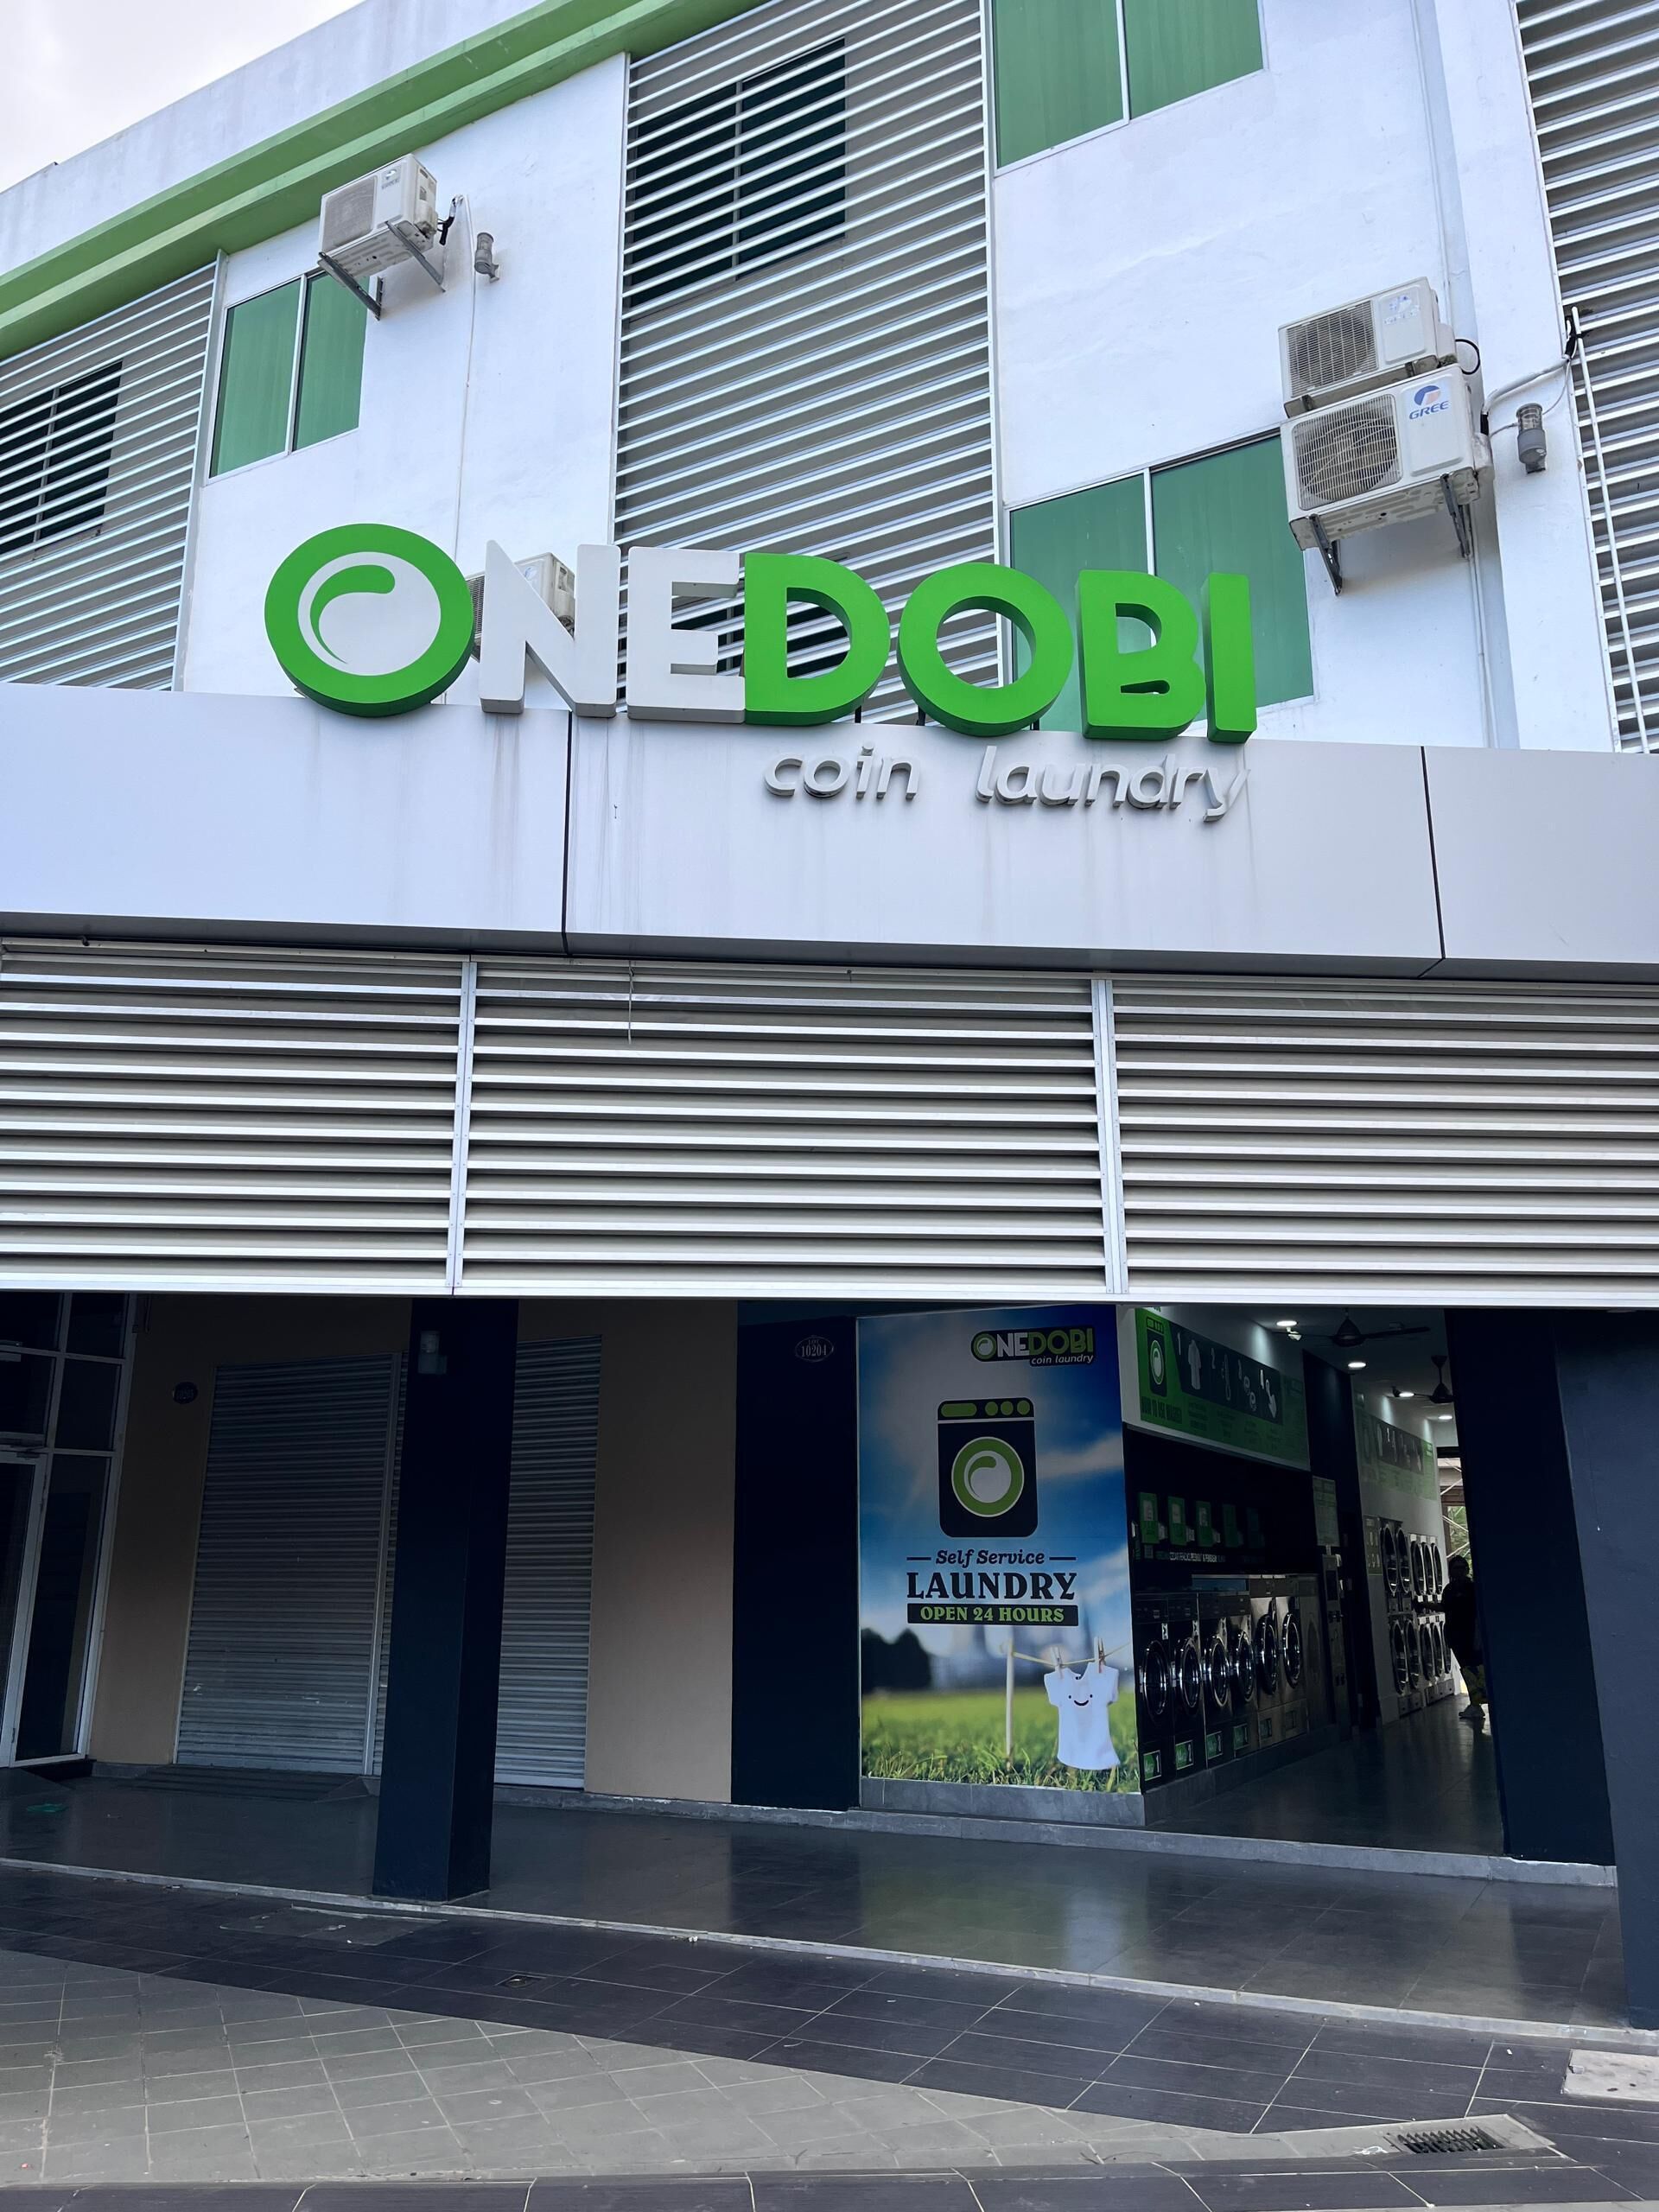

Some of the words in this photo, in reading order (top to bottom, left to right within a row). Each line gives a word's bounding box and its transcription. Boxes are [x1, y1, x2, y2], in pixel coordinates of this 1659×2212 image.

[1409, 400, 1450, 420] GREE
[264, 523, 1258, 745] ONEDOBI
[764, 741, 920, 800] coin
[975, 745, 1251, 823] laundry
[973, 1328, 1094, 1360] ONEDOBI
[1031, 1356, 1052, 1364] coin
[1055, 1354, 1094, 1364] laundry
[935, 1548, 975, 1568] Self
[976, 1549, 1045, 1565] Service
[906, 1572, 1077, 1600] LAUNDRY
[920, 1605, 969, 1621] OPEN
[973, 1607, 994, 1622] 24
[999, 1608, 1065, 1623] HOURS
